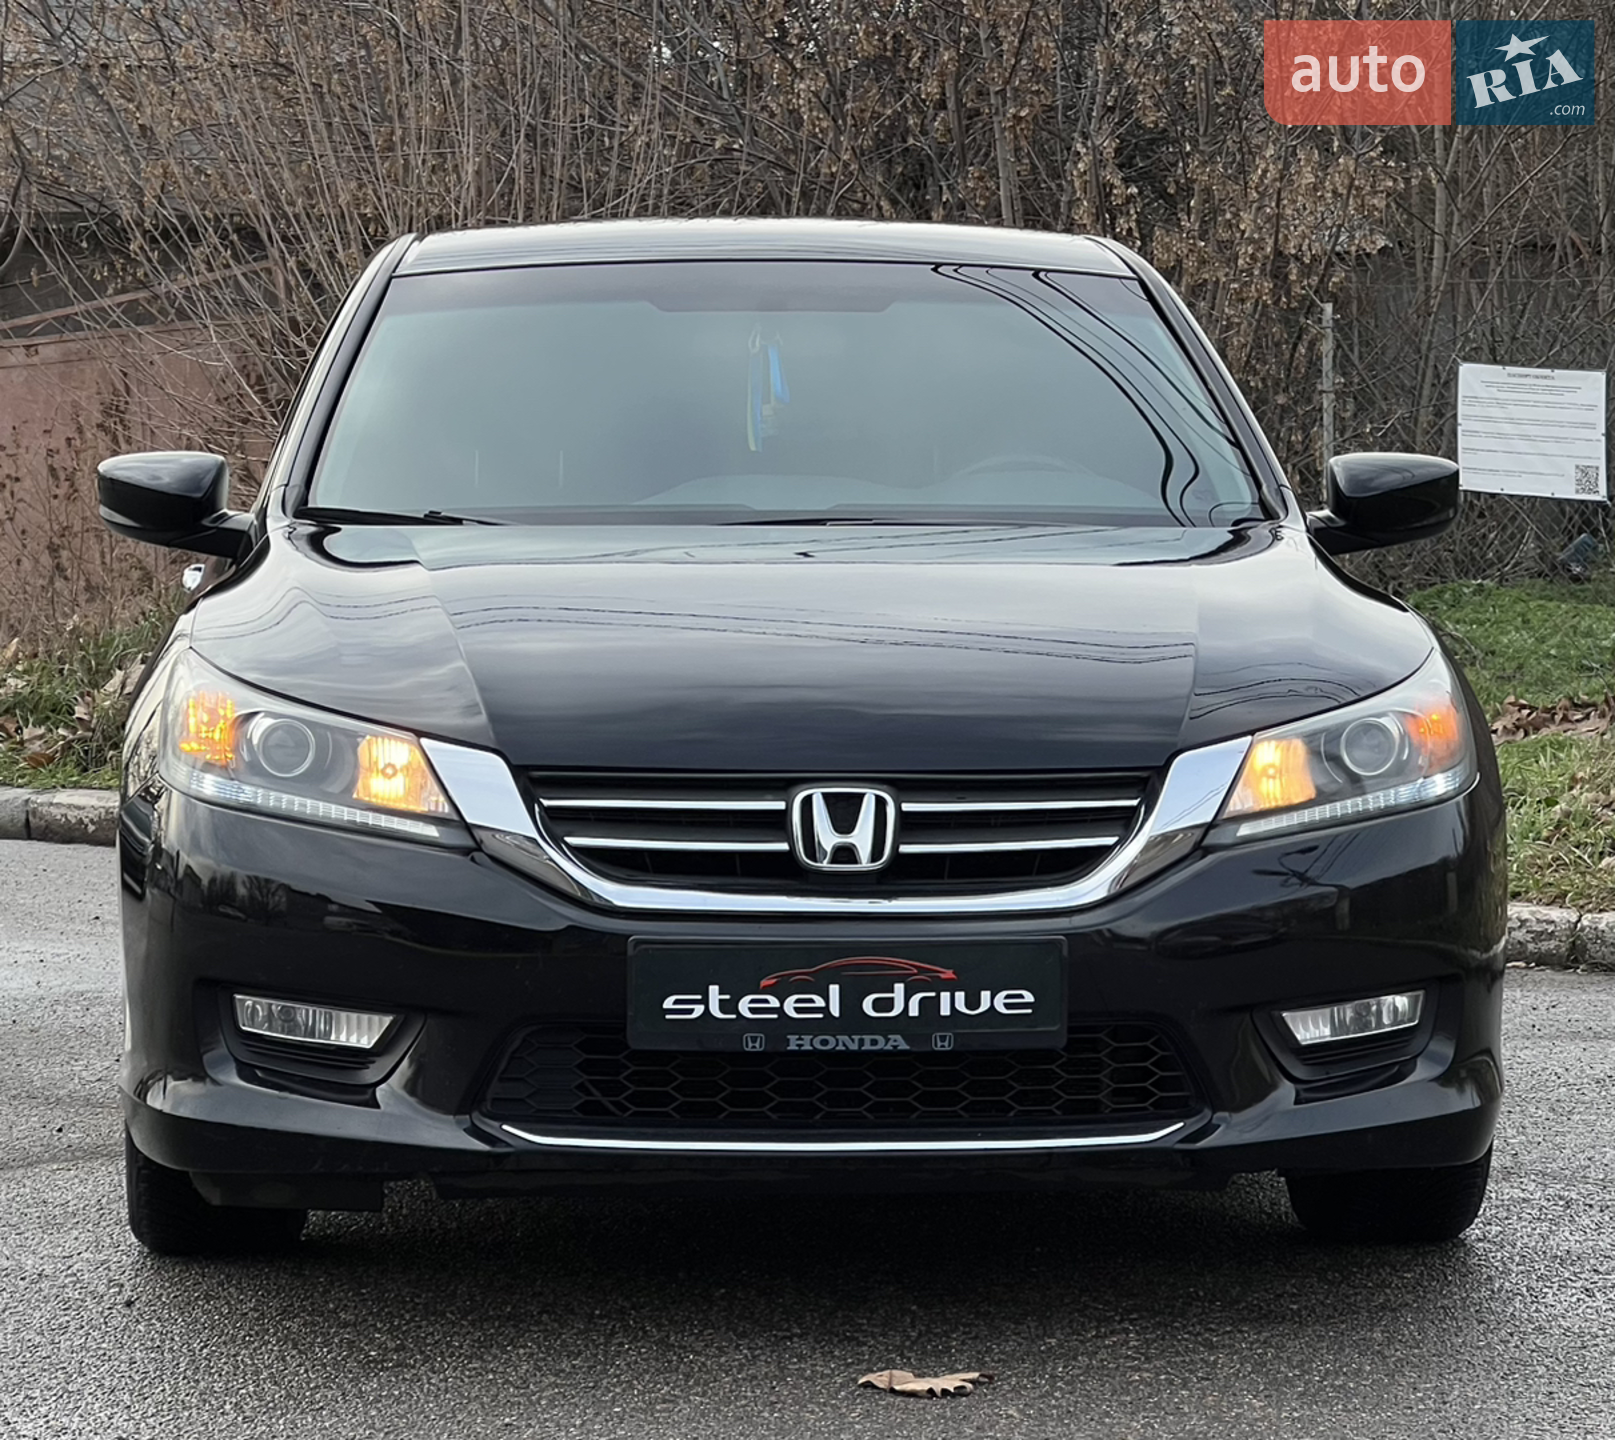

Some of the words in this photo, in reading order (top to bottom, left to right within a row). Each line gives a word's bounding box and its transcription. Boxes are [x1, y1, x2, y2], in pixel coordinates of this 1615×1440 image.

[662, 983, 839, 1020] steel
[862, 982, 1035, 1018] drive
[786, 1034, 911, 1051] HONDA
